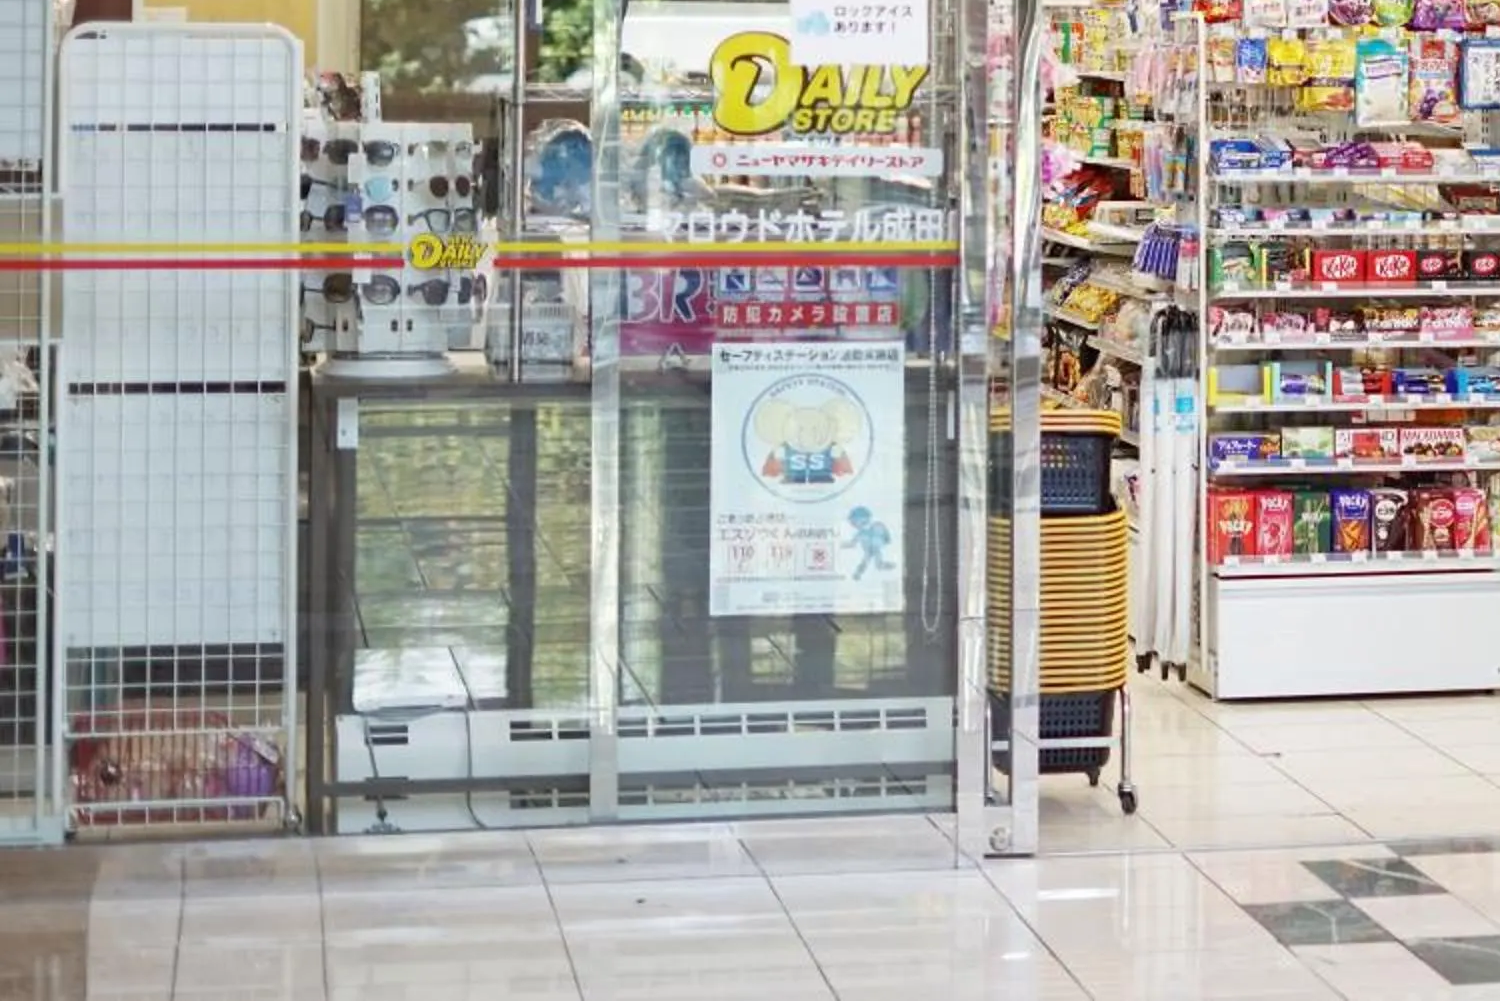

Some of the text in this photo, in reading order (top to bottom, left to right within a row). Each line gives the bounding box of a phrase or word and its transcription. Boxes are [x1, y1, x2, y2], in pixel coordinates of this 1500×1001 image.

[834, 4, 913, 18] ロックアイス
[709, 30, 930, 135] DAILY
[791, 108, 898, 134] STORE
